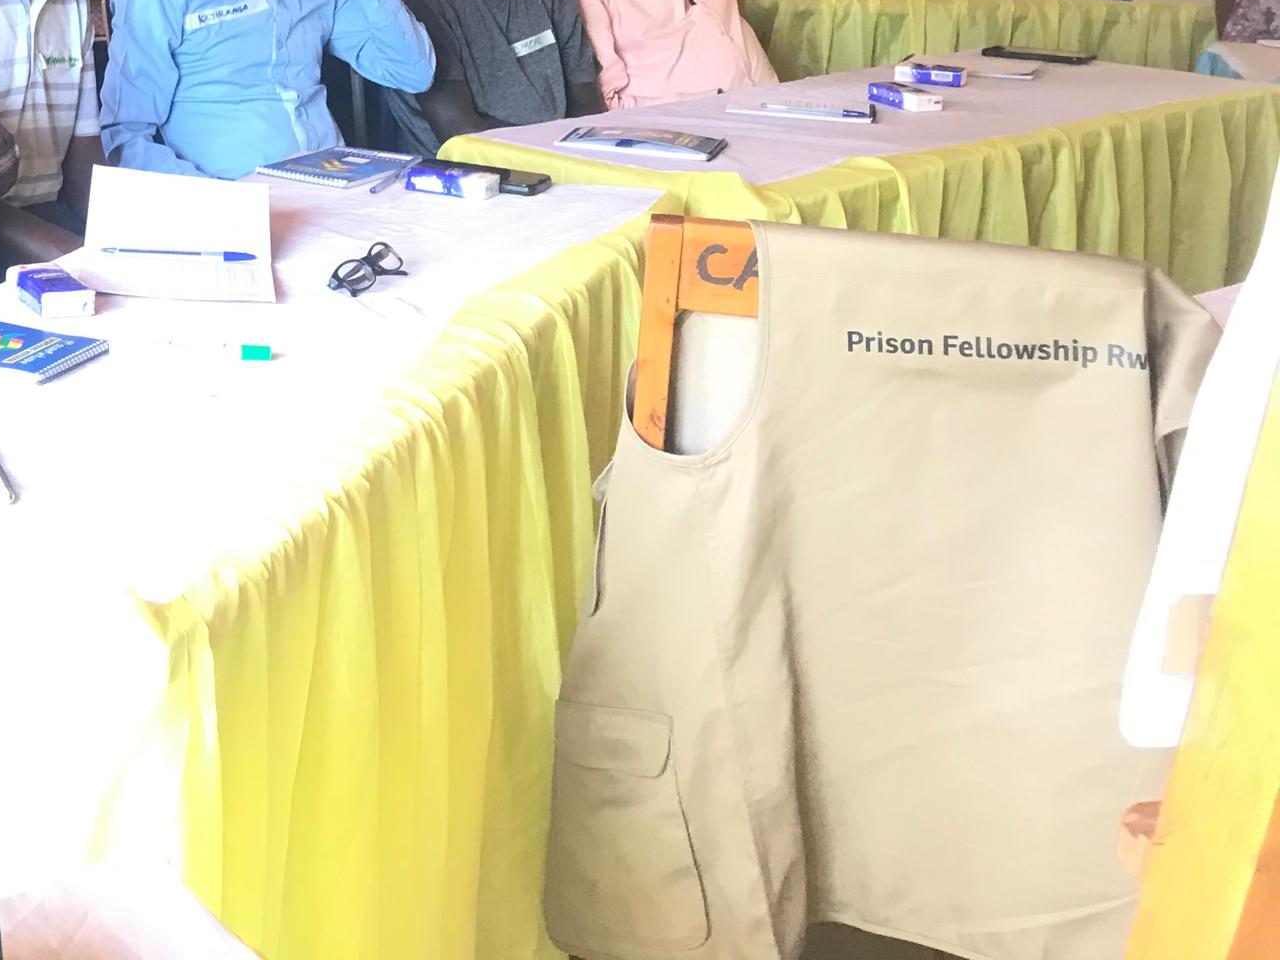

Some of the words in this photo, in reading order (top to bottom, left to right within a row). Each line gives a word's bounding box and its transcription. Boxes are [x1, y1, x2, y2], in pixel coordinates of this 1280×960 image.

[846, 330, 934, 356] Prison
[942, 334, 1098, 369] Fellowship
[1107, 343, 1150, 370] Rw
